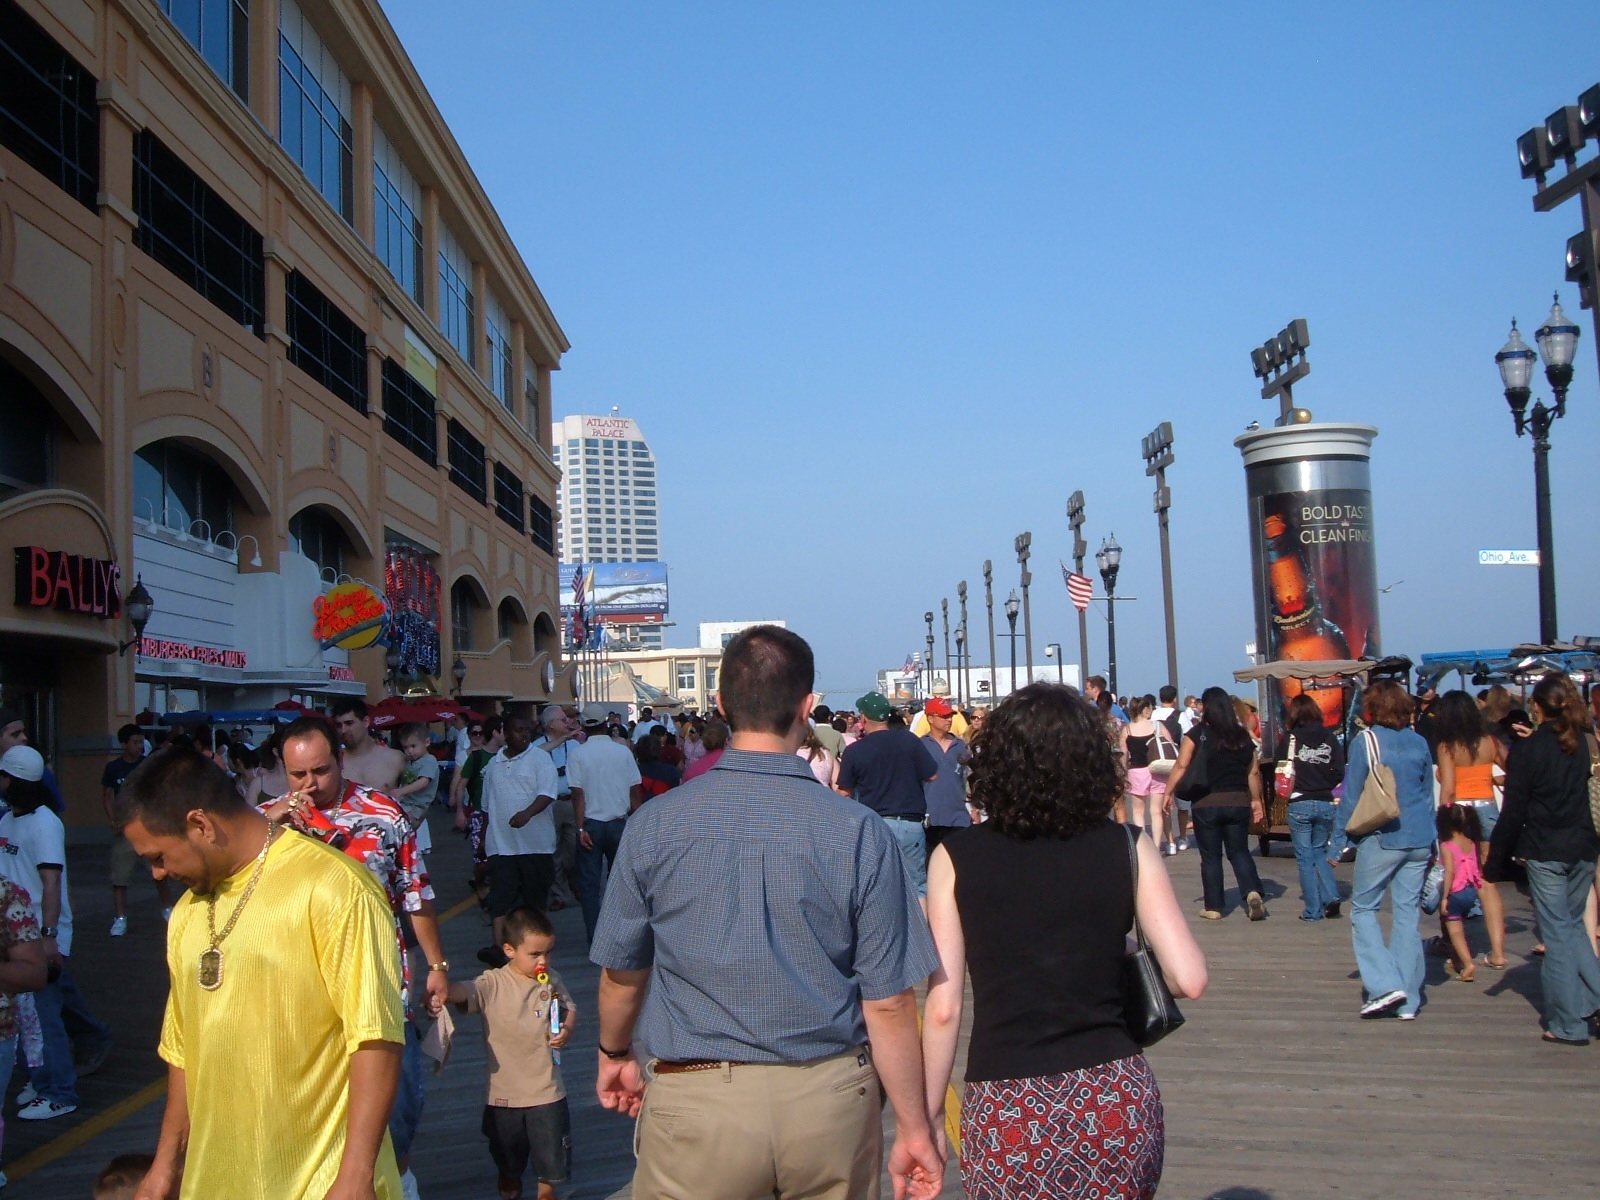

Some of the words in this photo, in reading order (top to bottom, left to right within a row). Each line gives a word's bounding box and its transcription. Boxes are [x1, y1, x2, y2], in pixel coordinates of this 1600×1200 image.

[586, 418, 630, 429] ATLANTIC
[592, 428, 625, 438] PALACE
[1302, 505, 1342, 521] BOLD
[1300, 529, 1346, 544] CLEAN
[1480, 551, 1503, 562] Ohio
[1508, 552, 1530, 562] Ave.
[31, 546, 121, 619] BALLY'S
[135, 636, 190, 660] MBURGERS
[194, 646, 218, 665] FRIES
[222, 650, 248, 668] MALTS
